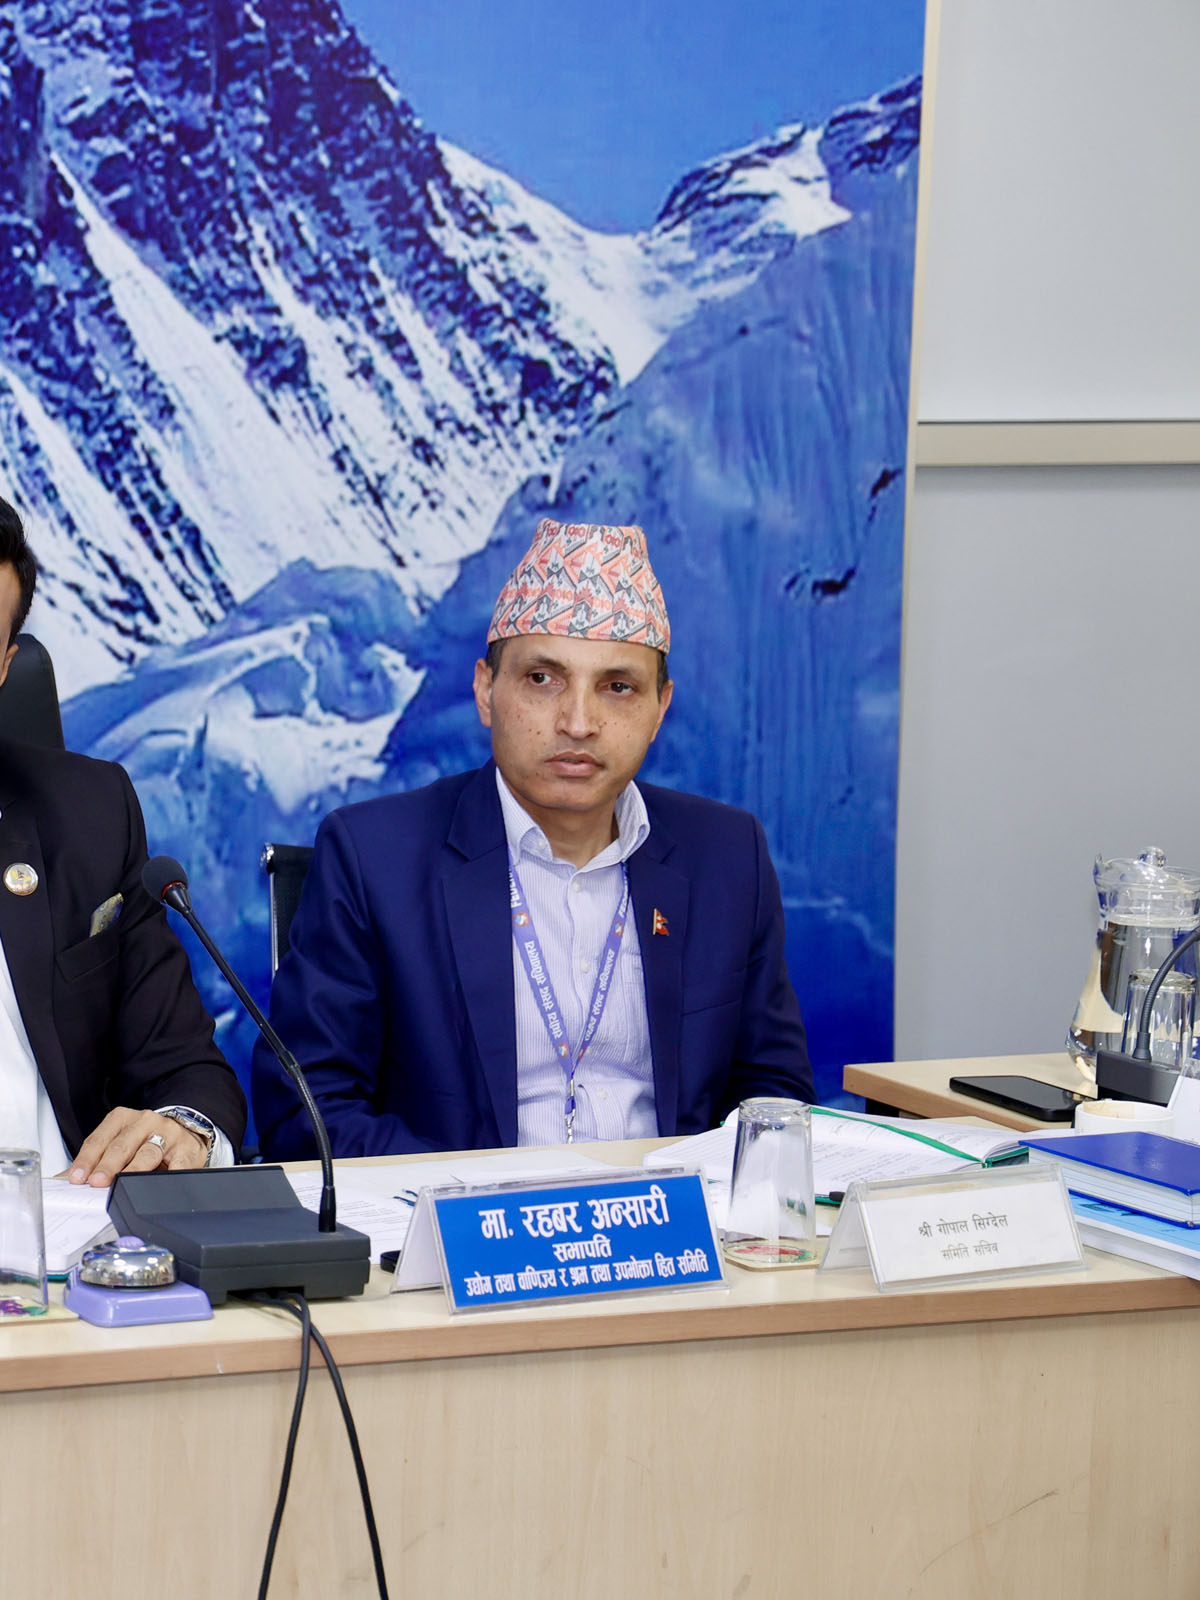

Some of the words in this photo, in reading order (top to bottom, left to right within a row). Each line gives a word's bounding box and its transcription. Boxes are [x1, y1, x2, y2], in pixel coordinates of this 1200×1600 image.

[524, 940, 547, 986] सचिवालय
[540, 985, 554, 1012] संसद
[547, 1012, 564, 1040] संघीय
[478, 1208, 514, 1239] मा.
[520, 1201, 582, 1238] रहबर
[587, 1184, 670, 1230] अन्सारी
[918, 1221, 933, 1238] श्री
[936, 1218, 970, 1235] गोपाल
[972, 1211, 1009, 1231] सिग्देल
[552, 1233, 612, 1263] सभापति
[940, 1244, 970, 1261] समिति
[973, 1239, 1000, 1256] सचिव
[463, 1270, 493, 1297] उद्योग
[493, 1273, 516, 1294] तथा
[517, 1264, 557, 1291] वाणिज्य
[558, 1267, 569, 1288] र
[568, 1265, 590, 1287] श्रम
[589, 1263, 612, 1284] तथा
[654, 1251, 676, 1278] हित
[676, 1247, 710, 1276] समिति
